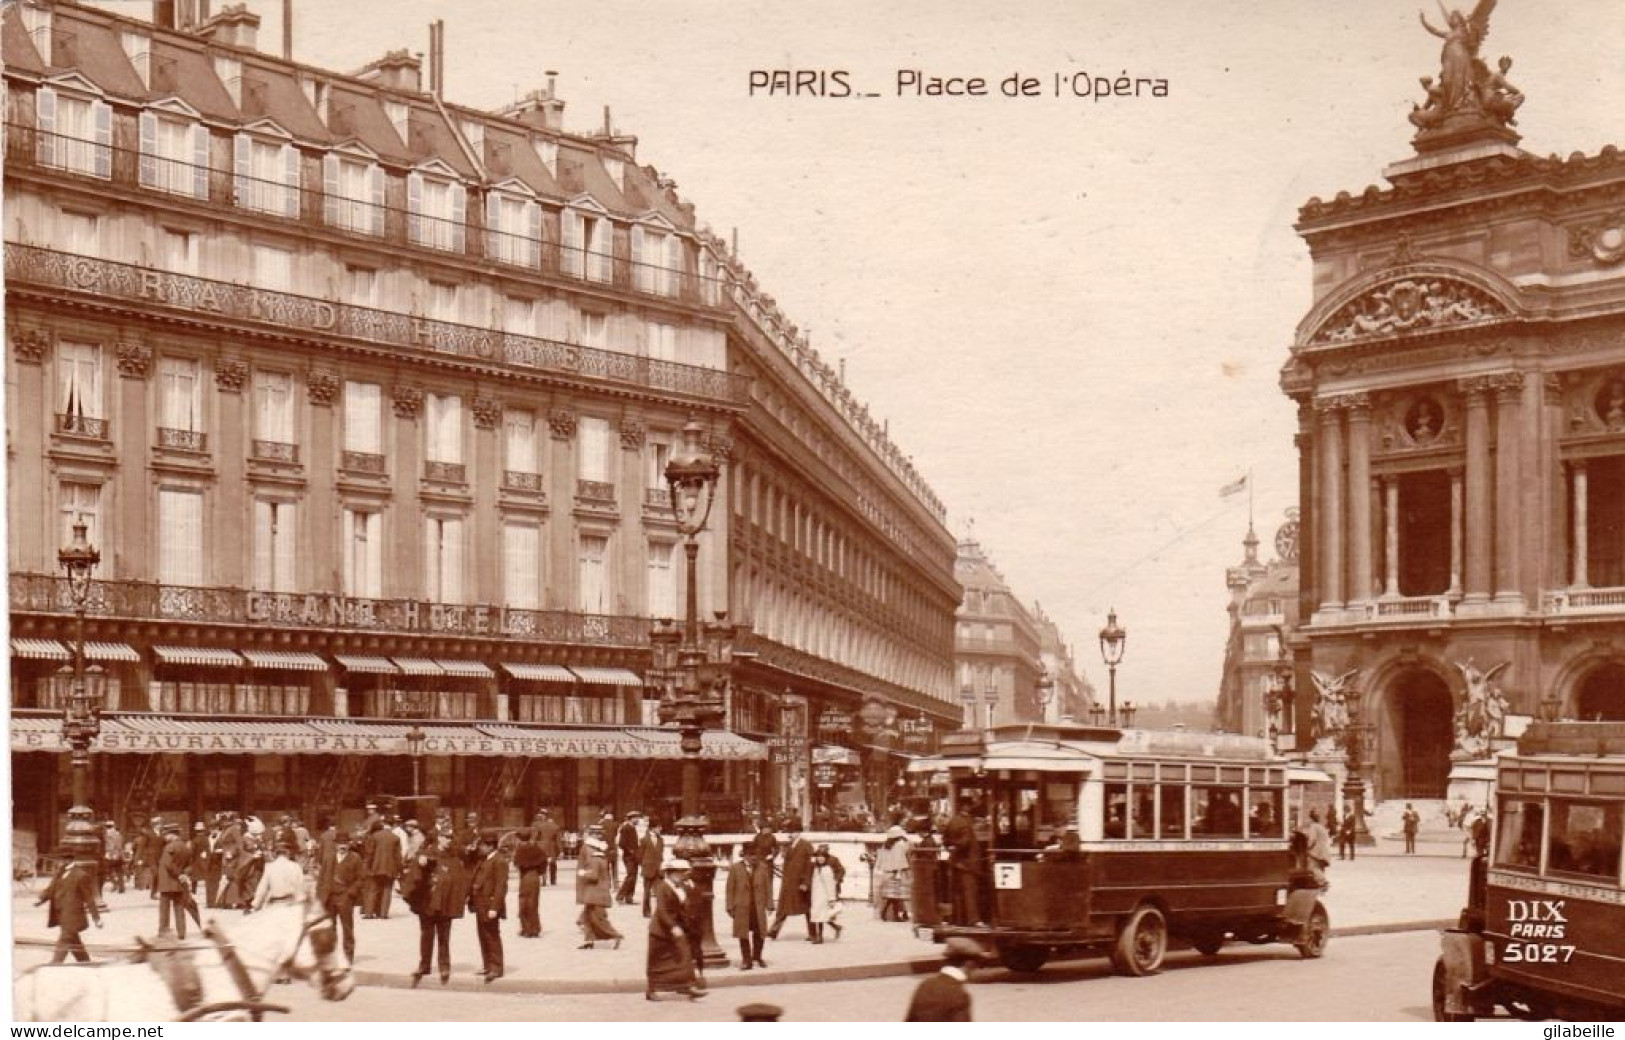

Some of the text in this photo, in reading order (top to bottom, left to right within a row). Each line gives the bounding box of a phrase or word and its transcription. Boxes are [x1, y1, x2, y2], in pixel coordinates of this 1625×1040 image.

[247, 591, 513, 634] GRAND HOTEL
[313, 737, 379, 750] PAIX
[1000, 866, 1015, 886] F
